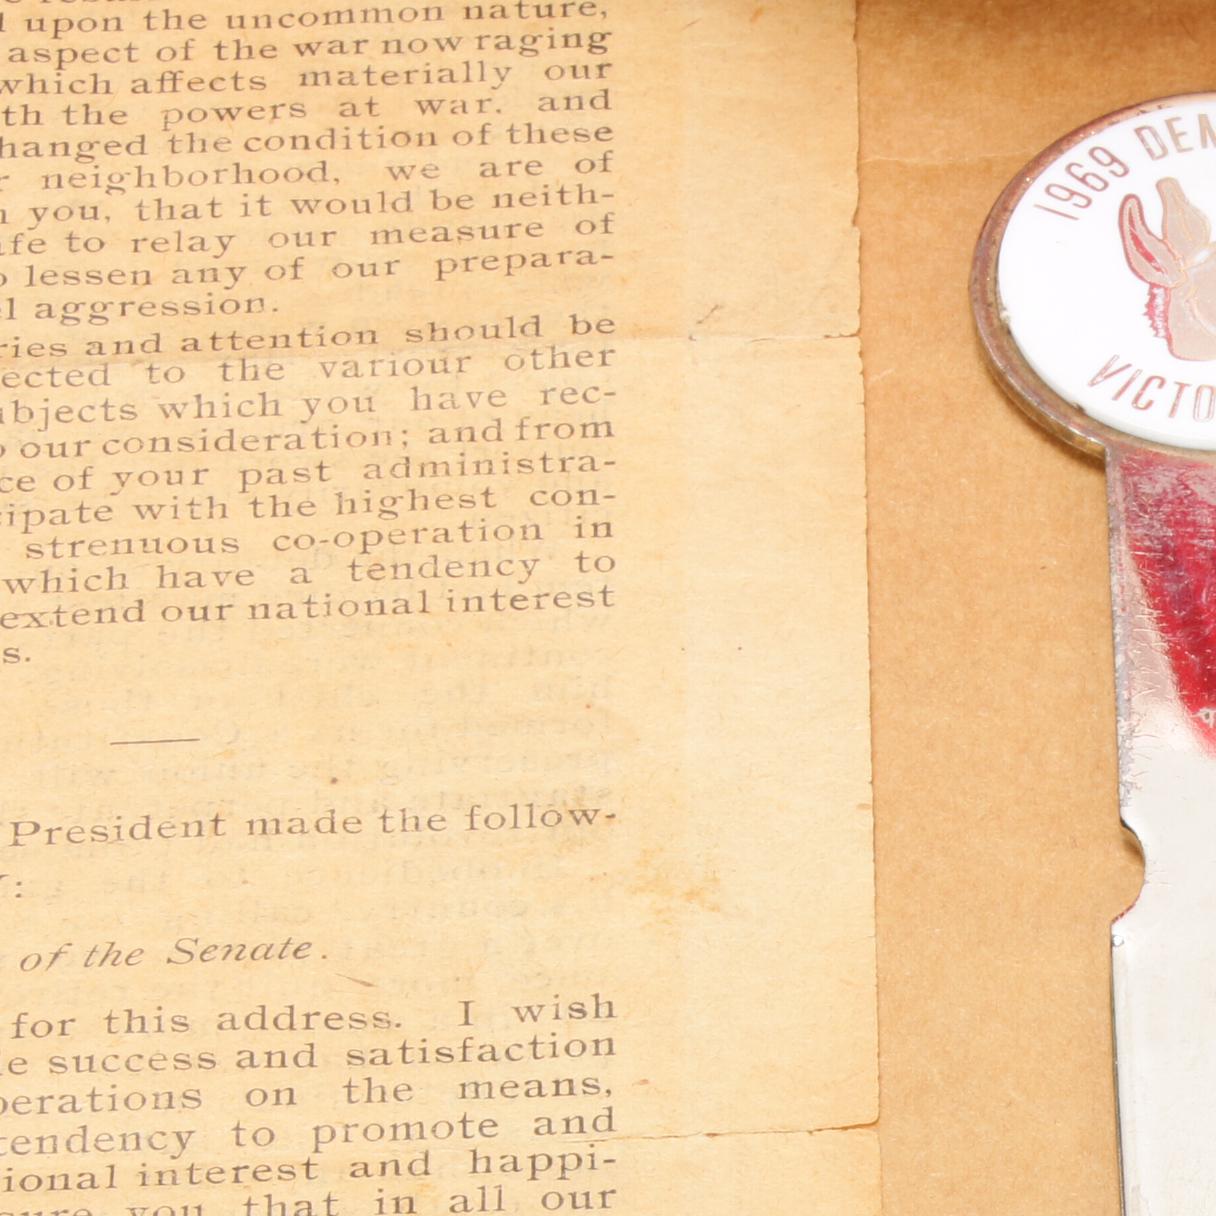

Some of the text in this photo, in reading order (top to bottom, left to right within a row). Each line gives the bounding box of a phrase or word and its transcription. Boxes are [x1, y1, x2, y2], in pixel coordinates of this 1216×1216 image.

[23, 0, 607, 40] upon the uncommon nature,
[7, 26, 613, 71] aspect of the war now raging
[0, 60, 613, 95] which affects materially our
[61, 102, 128, 126] the
[161, 102, 307, 132] powers
[338, 95, 380, 118] at
[537, 87, 612, 112] and
[167, 122, 614, 155] the condition of these
[385, 164, 440, 182] we
[479, 159, 543, 179] are
[574, 149, 614, 175] of
[1033, 146, 1130, 220] 1969
[27, 183, 615, 231] you, that it would be neith-
[64, 211, 615, 260] to relay our measure of
[25, 250, 614, 291] lessen any of our prepara-
[34, 291, 279, 327] aggression.
[85, 313, 616, 357] and attention should be
[145, 363, 186, 385] to
[218, 357, 285, 382] the
[504, 345, 616, 372] other
[158, 385, 617, 425] which you have rec-
[19, 415, 615, 459] our consideration; and from
[52, 451, 616, 497] of your past administra-
[132, 486, 616, 521] with the highest con-
[25, 515, 614, 560] strenuous co-operation in
[1, 550, 616, 595] which have a tendency to
[0, 584, 615, 630] extend our national interest
[8, 802, 617, 847] President made the follow-
[19, 936, 328, 972] of the Senate.
[10, 992, 618, 1040] for this address. I wish
[48, 1031, 617, 1075] success and satisfaction
[245, 1076, 612, 1108] on the means,
[231, 1105, 617, 1154] to promote and
[137, 1143, 617, 1187] interest and happi-
[375, 1188, 418, 1216] in
[448, 1184, 506, 1214] all
[540, 1188, 617, 1211] our
